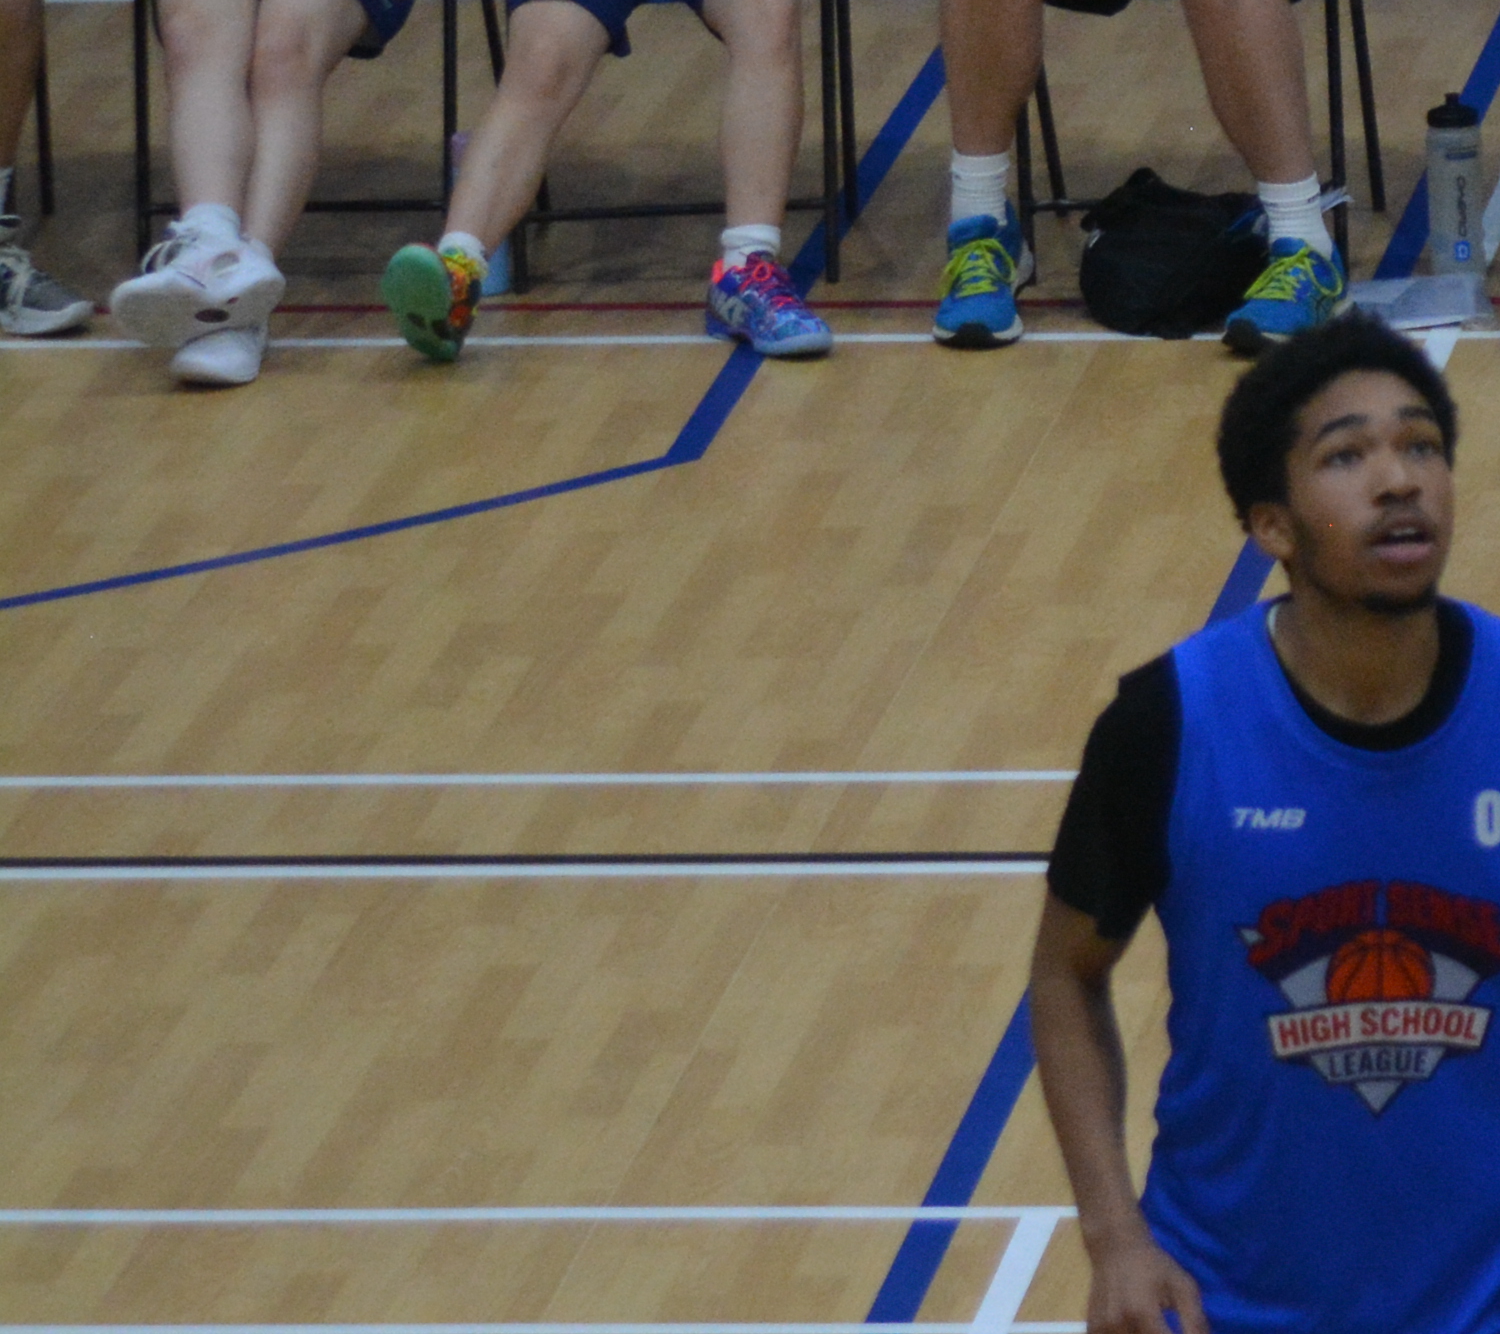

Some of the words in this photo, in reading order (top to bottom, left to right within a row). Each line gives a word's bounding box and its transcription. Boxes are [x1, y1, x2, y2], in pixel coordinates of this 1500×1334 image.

[1230, 805, 1307, 832] TMB
[1277, 1014, 1351, 1049] HIGH
[1359, 1006, 1478, 1041] SCHOOL
[1328, 1047, 1431, 1079] LEAGUE
